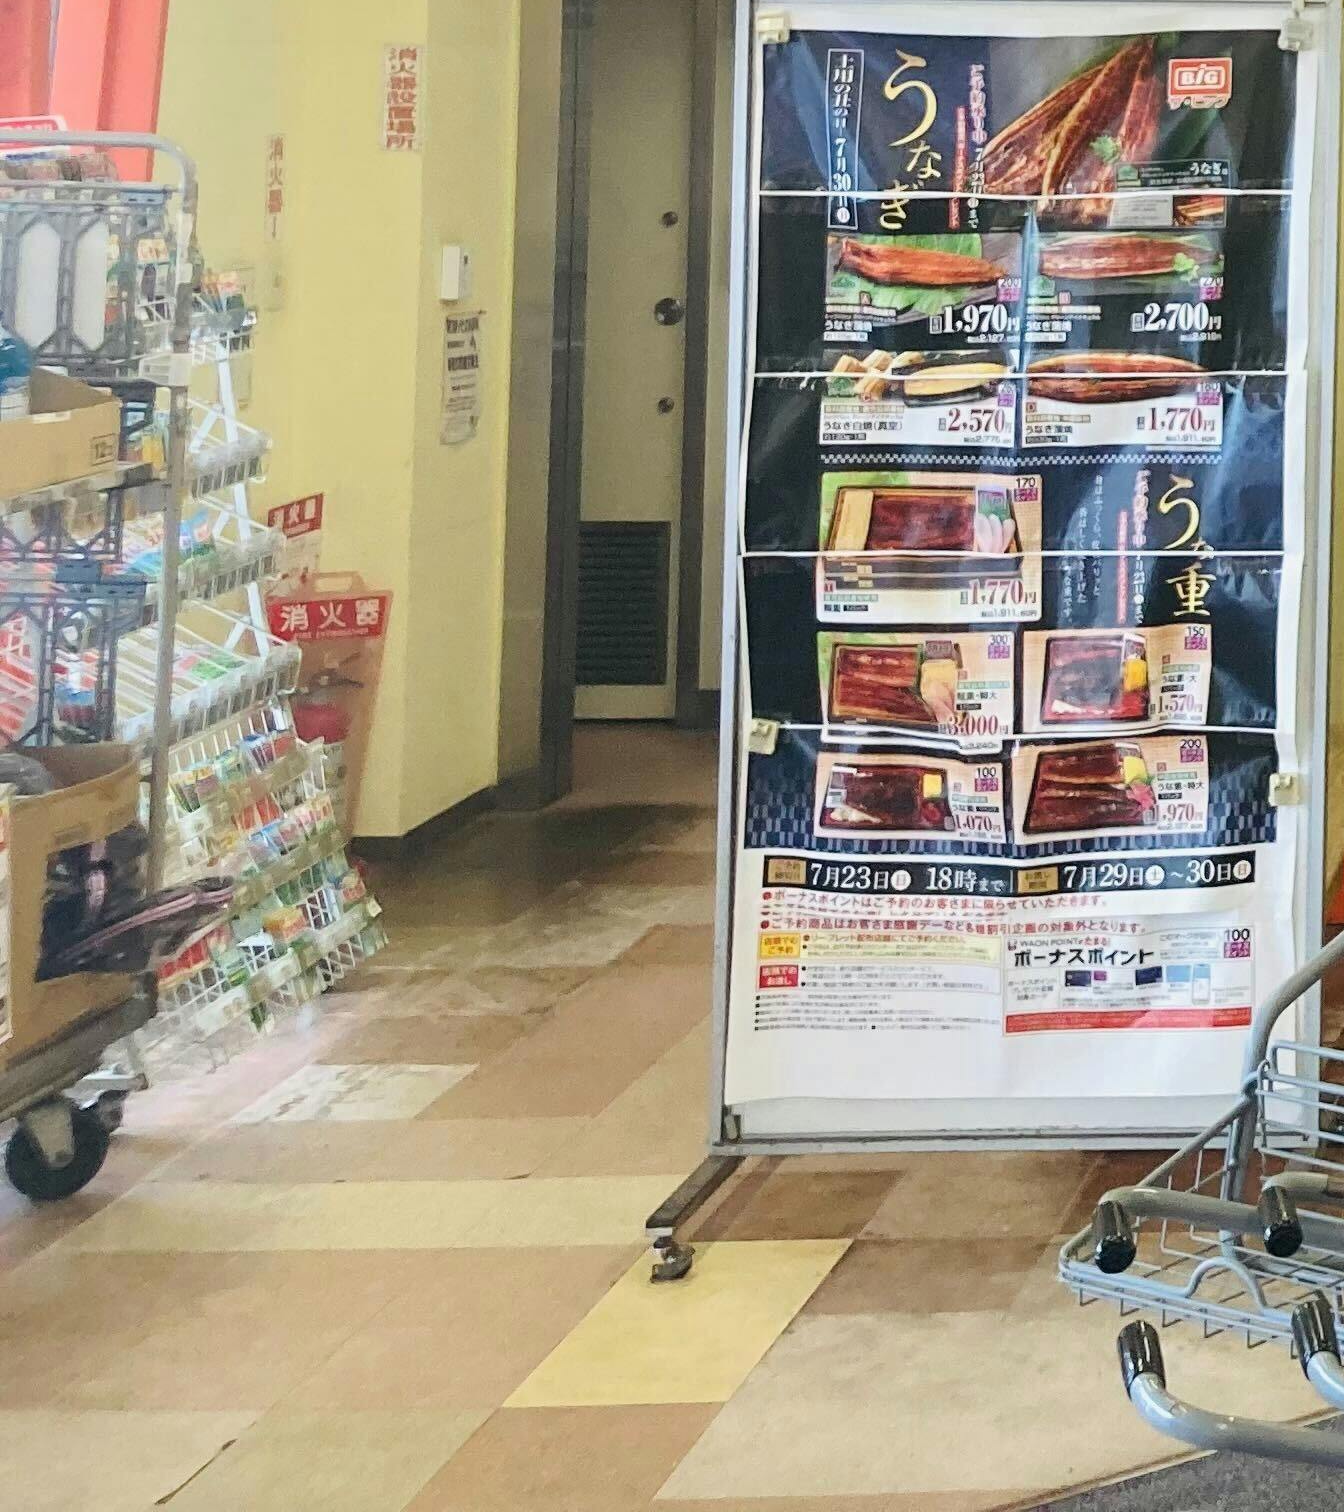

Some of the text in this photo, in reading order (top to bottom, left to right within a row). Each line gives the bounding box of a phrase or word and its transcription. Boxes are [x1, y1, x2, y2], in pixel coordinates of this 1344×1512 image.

[1015, 473, 1036, 488] 170
[279, 598, 381, 633] 消火器
[976, 766, 997, 778] 100
[925, 865, 1005, 893] 18時まで
[1223, 928, 1251, 942] 100
[1013, 948, 1155, 968] ボーナスポイント
